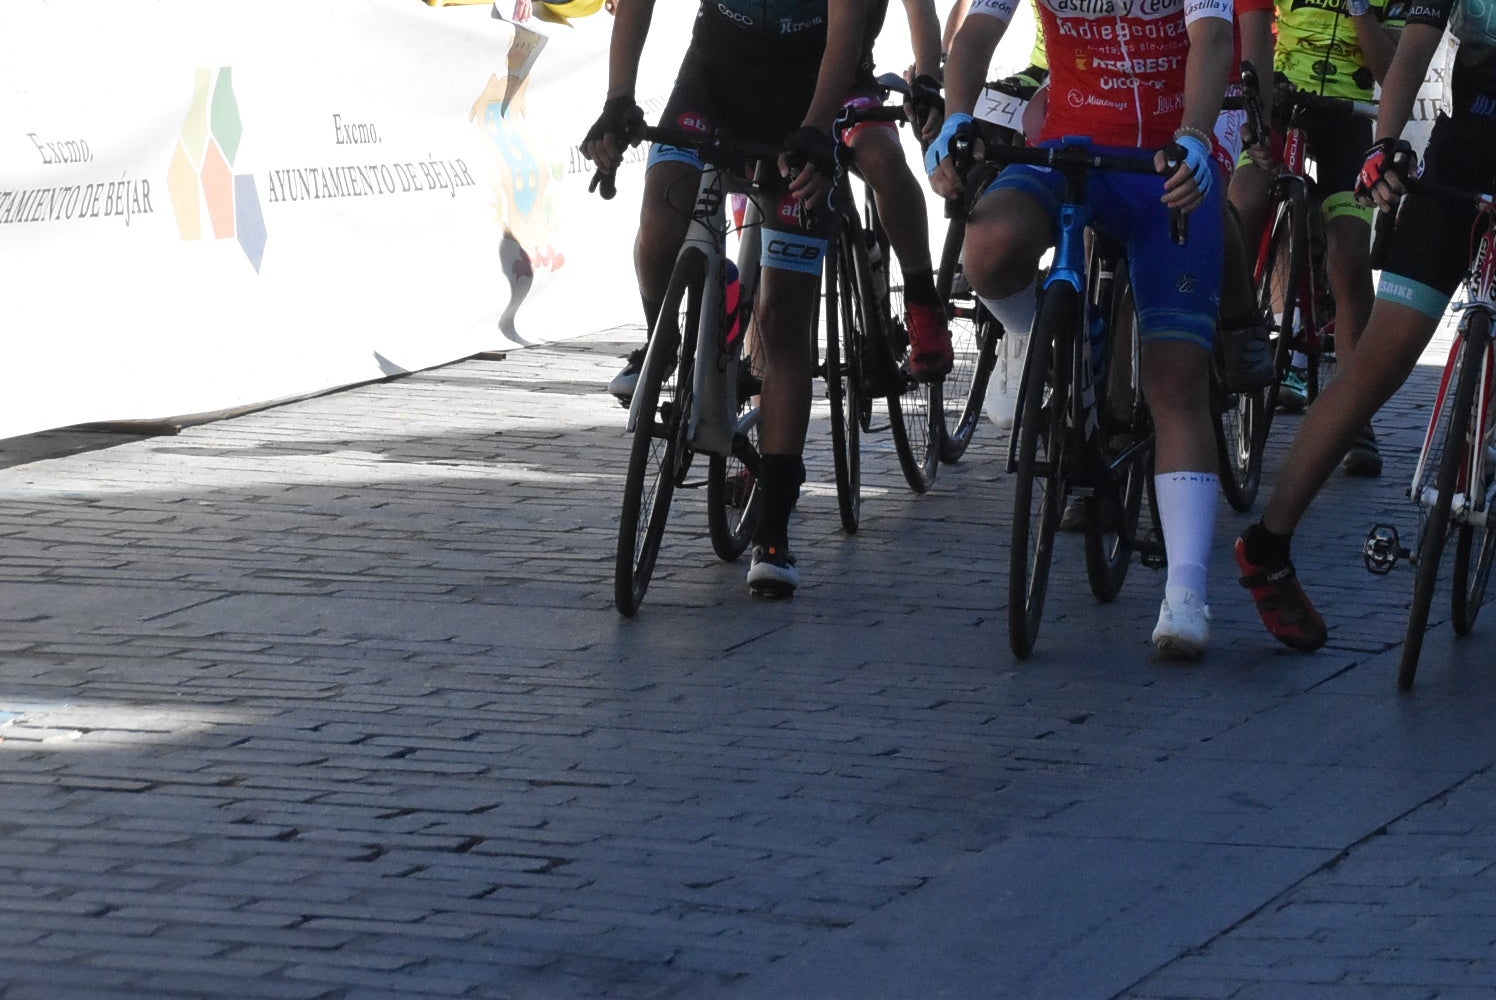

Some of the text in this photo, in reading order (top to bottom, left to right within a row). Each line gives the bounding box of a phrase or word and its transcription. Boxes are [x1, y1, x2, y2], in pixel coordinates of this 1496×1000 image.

[1122, 0, 1134, 16] y
[984, 97, 1018, 124] 74
[332, 113, 382, 145] Excmo.
[1288, 128, 1301, 174] FOCUS
[268, 153, 476, 202] AYUNTAMIENTO DE BÉJAR
[78, 182, 102, 218] DE
[104, 170, 154, 227] BÉJAR
[767, 239, 821, 260] CCB
